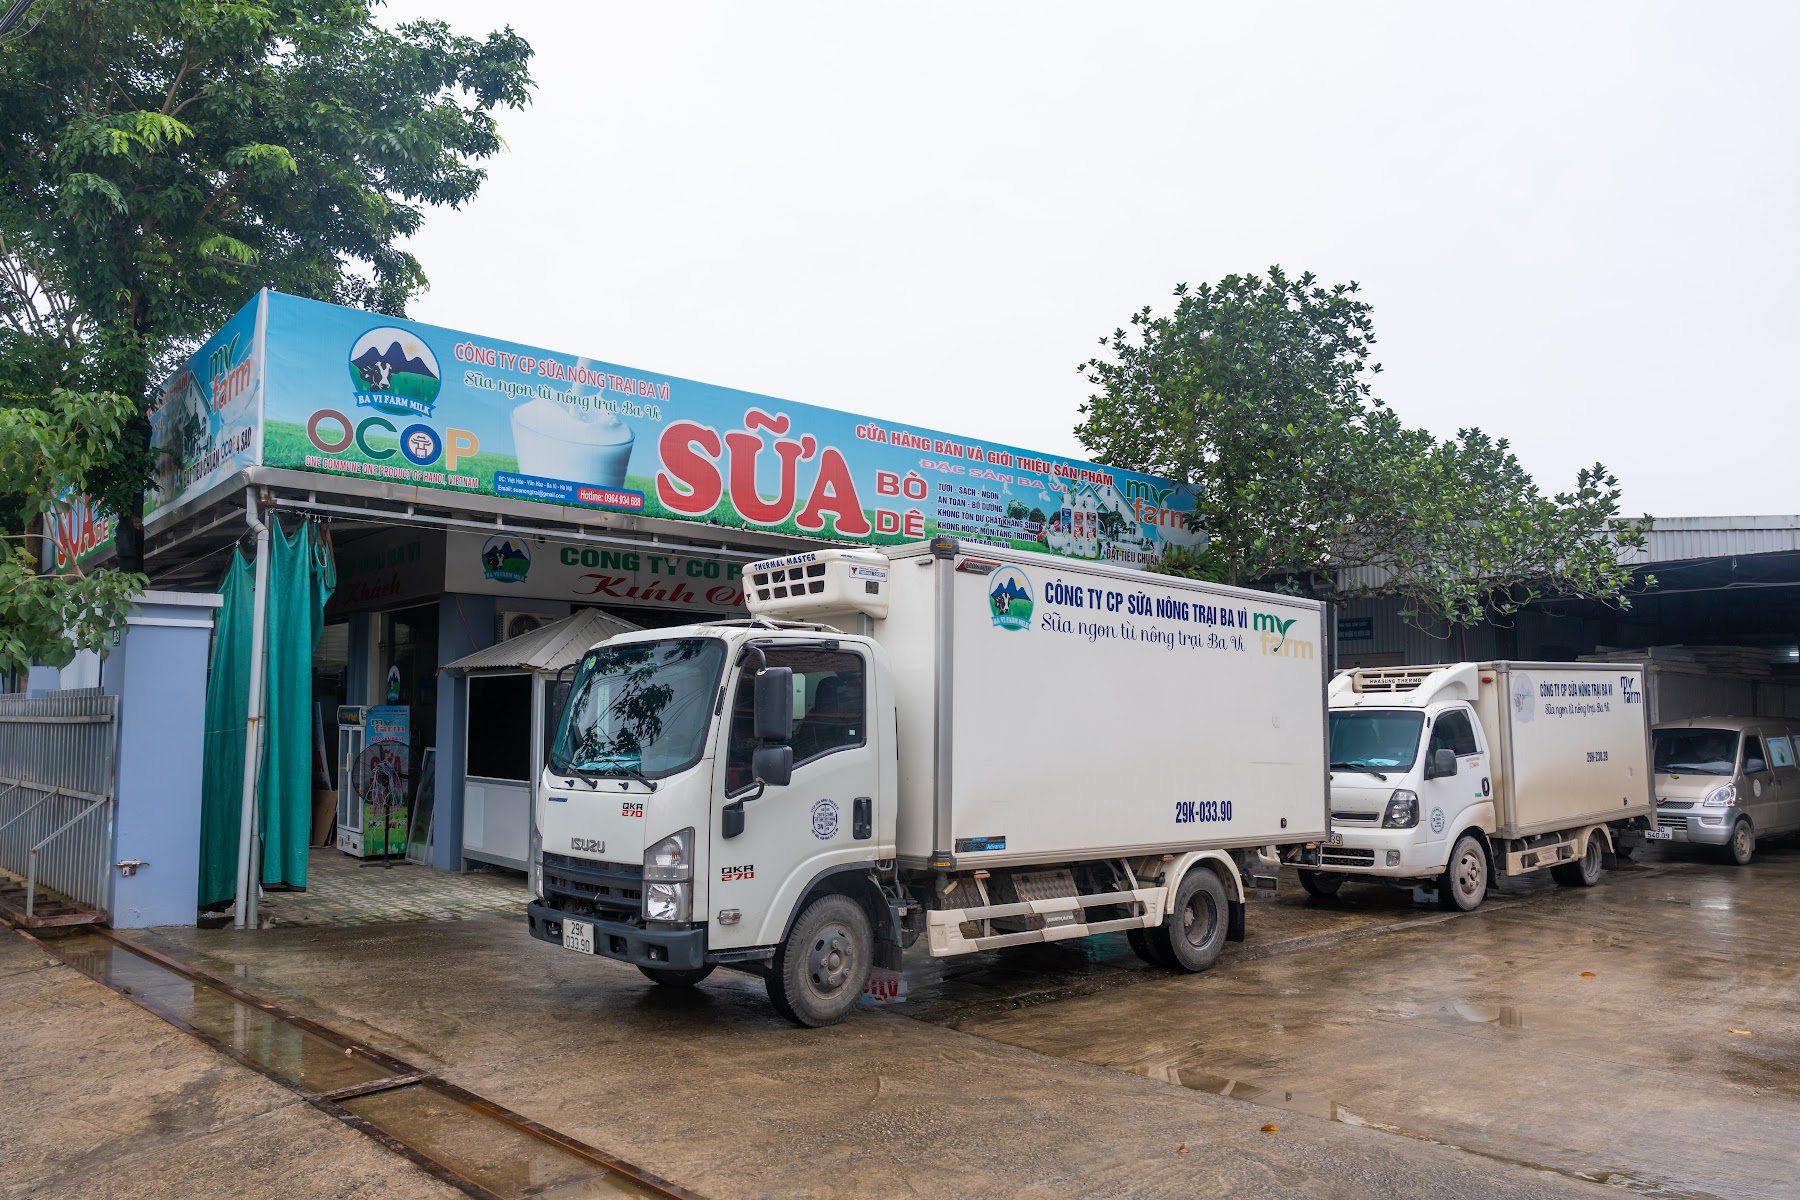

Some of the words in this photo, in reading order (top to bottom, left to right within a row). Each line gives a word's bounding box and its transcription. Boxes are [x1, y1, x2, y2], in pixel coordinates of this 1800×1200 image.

[455, 342, 495, 366] CÔNG
[498, 351, 516, 370] TY
[519, 356, 536, 373] CP
[538, 358, 565, 380] SỮA
[567, 366, 605, 388] NÔNG
[608, 374, 636, 395] TRẠI
[639, 380, 656, 398] BA
[657, 382, 670, 401] VÌ
[212, 359, 250, 414] farm
[358, 394, 371, 404] BA
[373, 394, 382, 403] VI
[384, 395, 408, 407] FARM
[410, 400, 430, 415] MILK
[498, 380, 535, 399] ngon
[557, 389, 590, 411] nông
[594, 396, 620, 415] trại
[622, 401, 643, 417] Ba
[307, 408, 479, 471] OCOP
[856, 423, 887, 443] CỬA
[891, 431, 931, 451] HÀNG
[934, 440, 963, 458] BÁN
[966, 446, 984, 461] VÀ
[987, 451, 1013, 467] GIỚI
[1016, 456, 1051, 475] THIỆU
[1054, 462, 1078, 480] SẢN
[1080, 468, 1113, 487] PHẨM
[305, 455, 321, 467] ONE
[323, 458, 361, 473] COMMUNE
[362, 463, 377, 475] ONE
[379, 465, 411, 480] PRODUCT
[413, 470, 422, 482] OF
[423, 472, 446, 485] HANOI,
[448, 475, 478, 488] VIETNAM
[656, 407, 870, 537] SỮA
[498, 485, 512, 493] Email:
[876, 469, 928, 501] BÒ
[959, 486, 976, 497] SẠCH
[981, 490, 999, 500] NGON
[1018, 477, 1045, 489] BA
[580, 489, 603, 502] Hotline:
[938, 495, 948, 505] AN
[1126, 479, 1176, 510] my
[875, 508, 925, 538] DÊ
[937, 521, 960, 532] KHÔNG
[938, 508, 960, 519] KHÔNG
[1024, 522, 1039, 531] SINH
[560, 543, 640, 572] CÔNG
[647, 555, 680, 575] TY
[686, 554, 720, 580] CỔ
[754, 560, 785, 571] THERMAL
[786, 553, 816, 565] MASTER
[1121, 548, 1135, 562] TIÊU
[571, 573, 698, 604] Kính
[1045, 578, 1083, 608] CÔNG
[1087, 588, 1103, 610] TY
[1106, 591, 1123, 612] CP
[1127, 591, 1153, 616] SỮA
[1156, 596, 1189, 621] NÔNG
[1192, 603, 1217, 628] TRẠI
[1220, 607, 1235, 628] BA
[1238, 607, 1248, 629] VÌ
[1253, 612, 1298, 637] my
[1079, 621, 1118, 643] ngon
[1141, 626, 1175, 650] nông
[1178, 630, 1204, 650] trại
[1207, 633, 1228, 650] Ba
[1230, 634, 1246, 652] Vì
[1260, 631, 1313, 660] farm
[1540, 681, 1553, 697] CÔNG
[1554, 684, 1560, 697] TY
[1560, 683, 1567, 697] CP
[1602, 683, 1608, 696] BA
[1620, 676, 1634, 689] my
[1623, 687, 1641, 703] farm
[374, 725, 405, 733] farm
[622, 802, 643, 810] QKR
[1175, 800, 1232, 823] 29K-033.90
[571, 837, 605, 854] ISUZU
[721, 865, 754, 875] QKR
[721, 872, 754, 882] 270
[570, 921, 585, 937] 29K
[566, 936, 590, 953] 033.90
